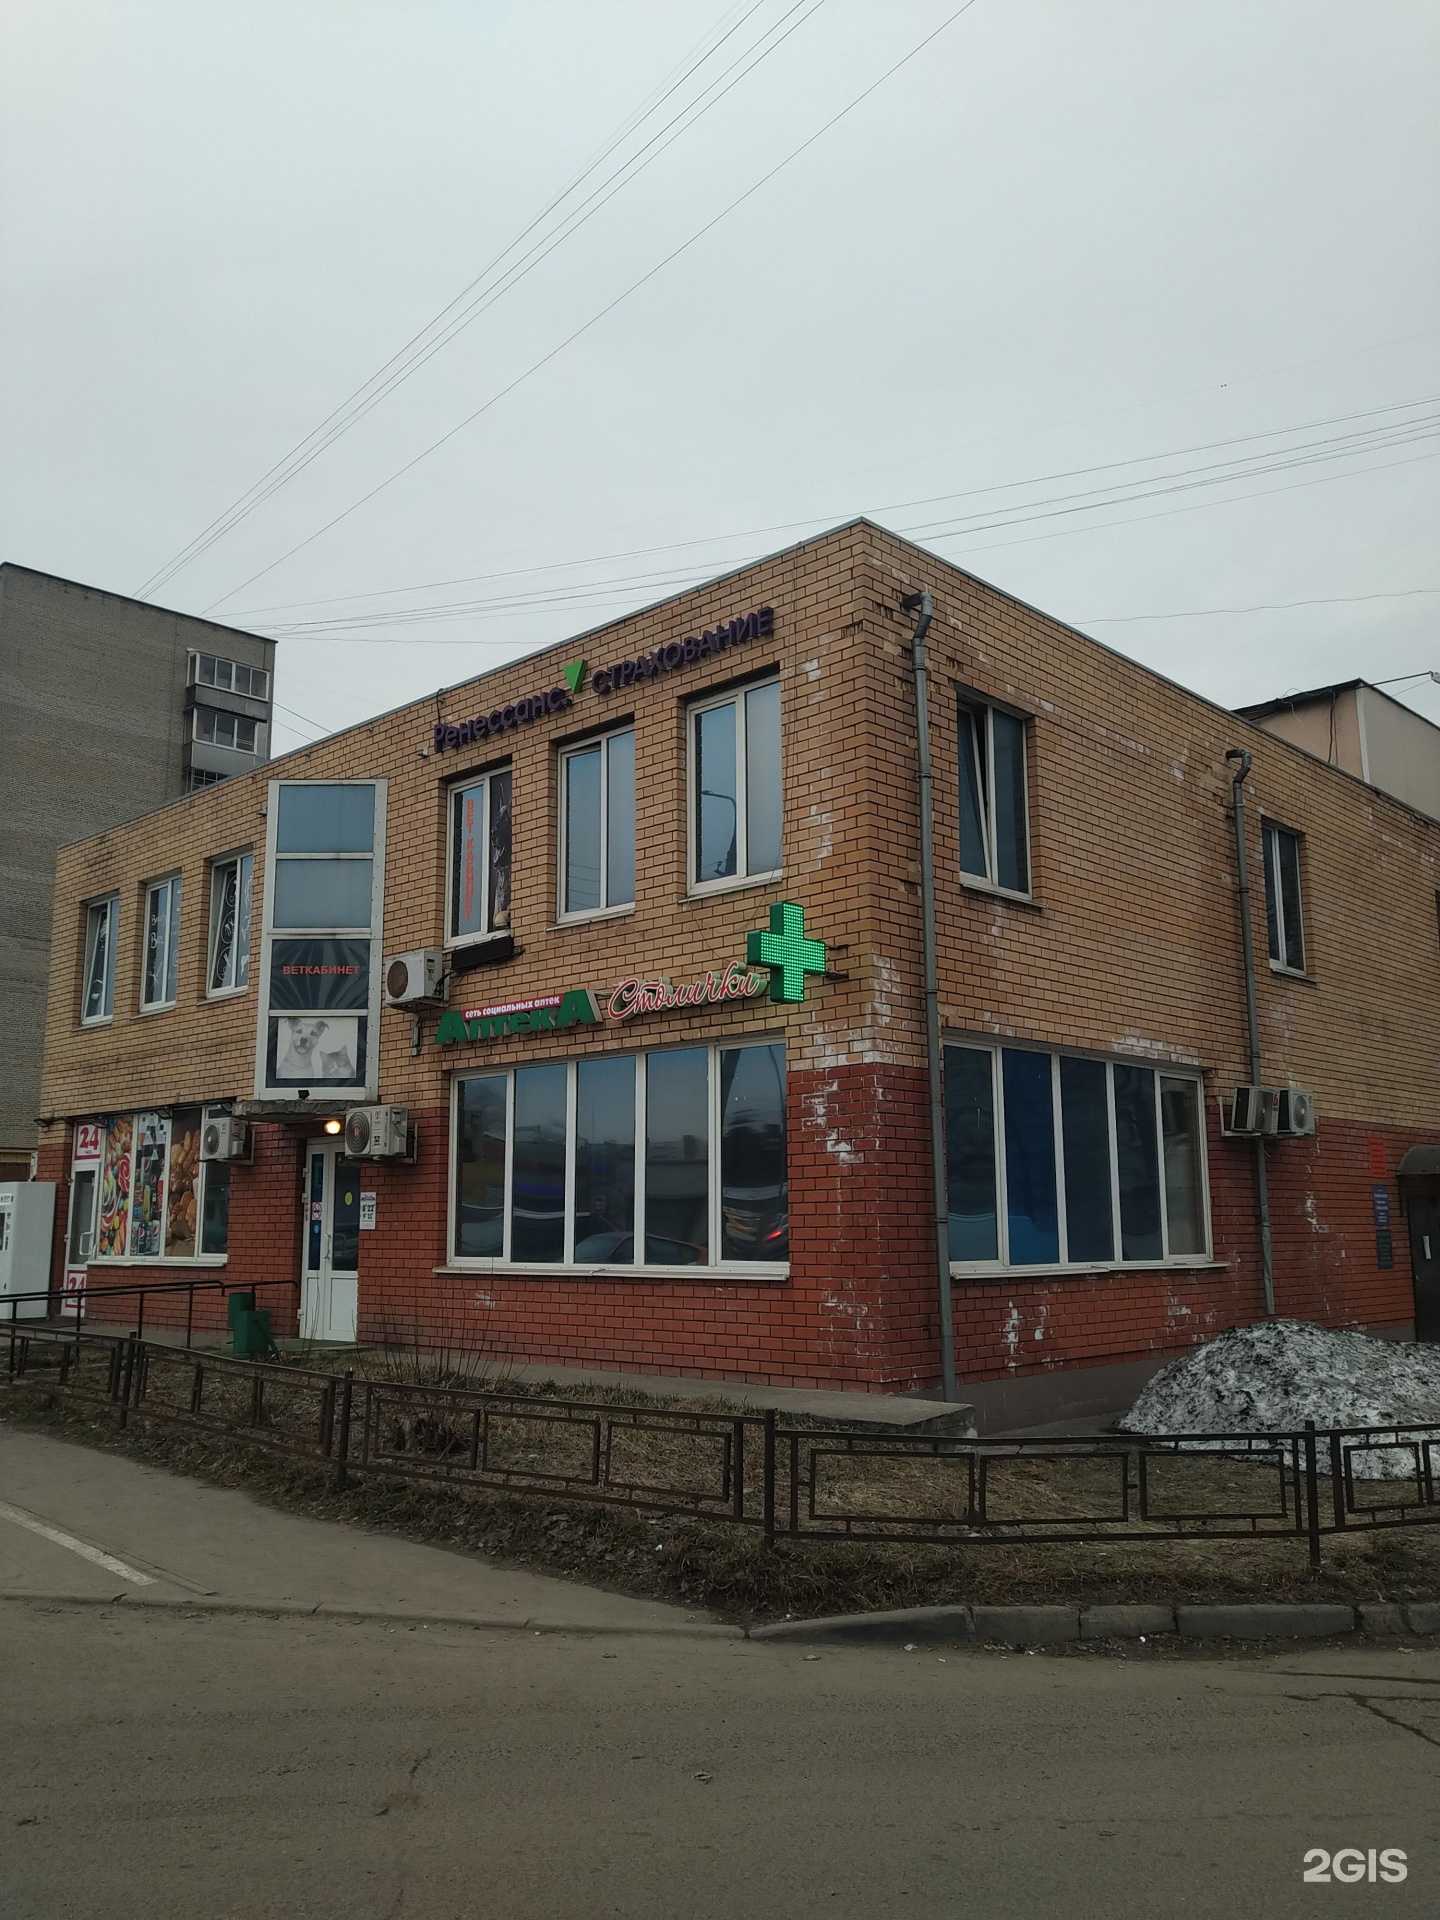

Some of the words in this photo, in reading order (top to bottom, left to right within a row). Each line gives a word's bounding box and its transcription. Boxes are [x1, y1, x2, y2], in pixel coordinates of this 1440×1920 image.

[591, 606, 774, 695] СТРАХОВАНИЕ
[281, 965, 361, 976] ВЕТКАБИНЕТ
[608, 960, 764, 1020] Столички
[465, 1008, 482, 1019] сеть
[482, 1000, 533, 1016] социальных
[534, 995, 560, 1009] аптек
[80, 1126, 99, 1150] 24
